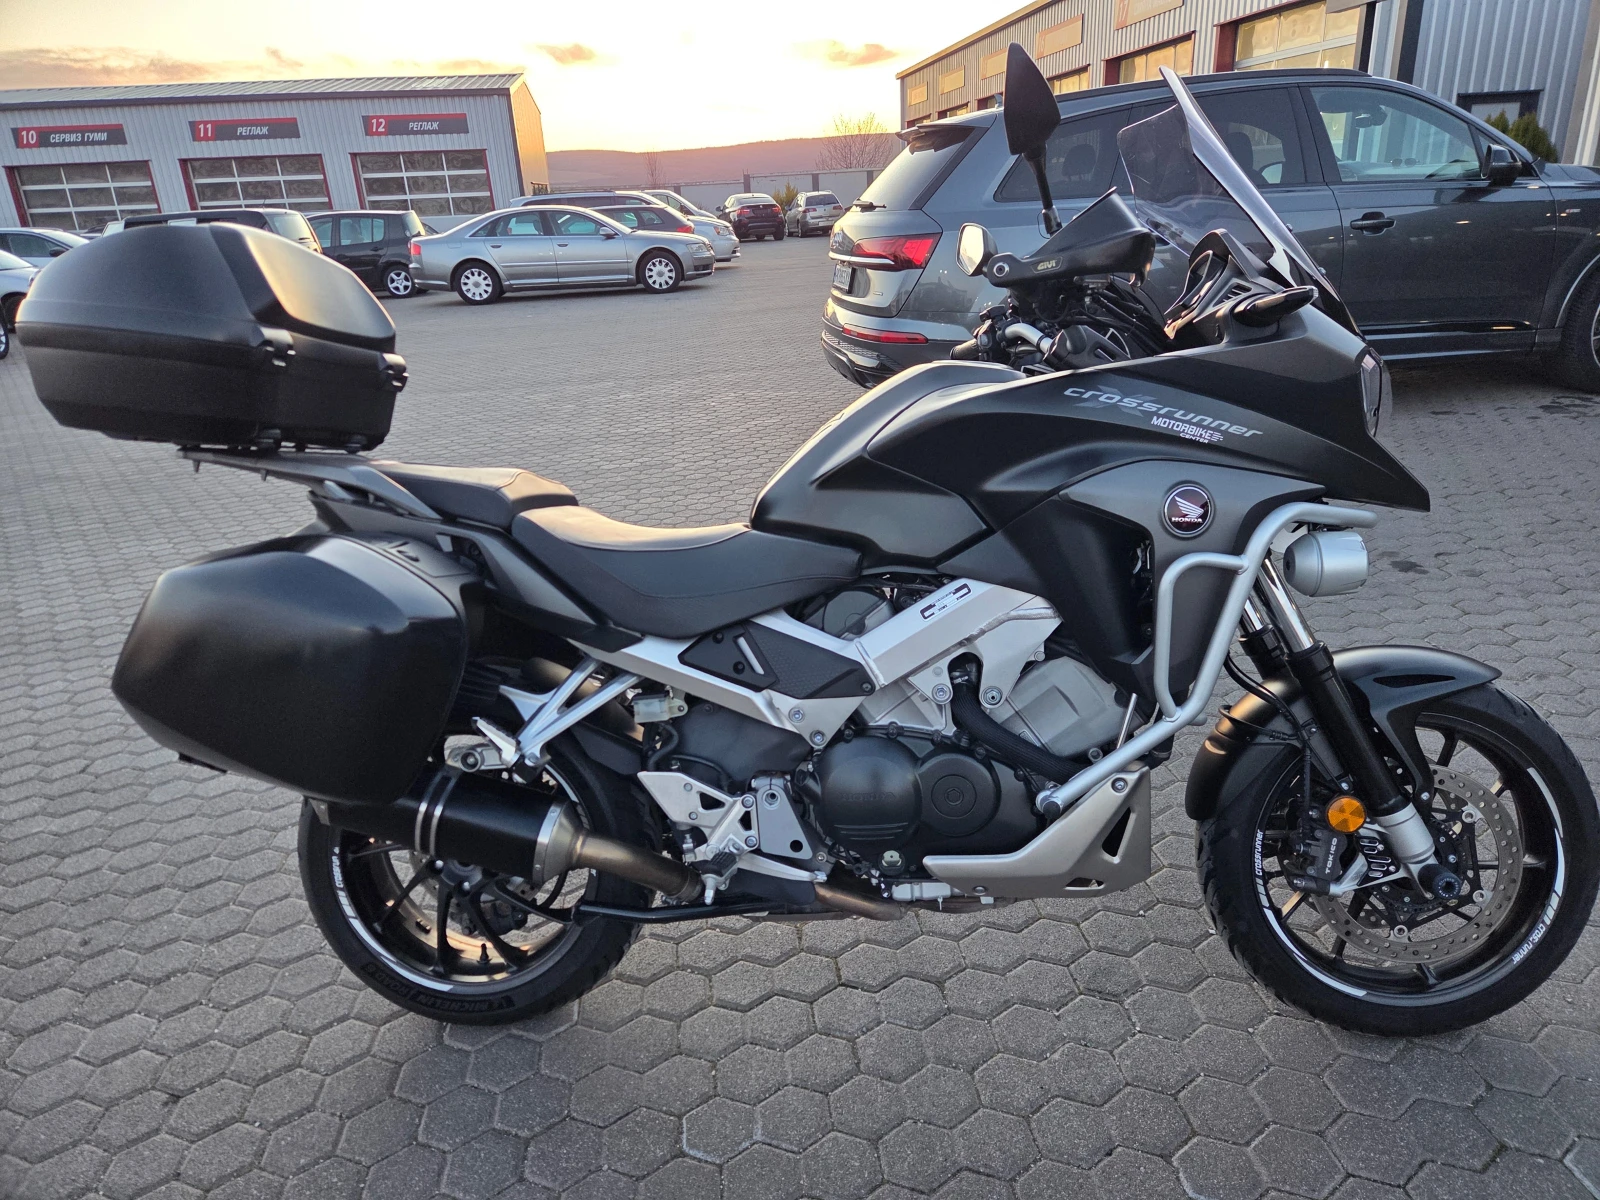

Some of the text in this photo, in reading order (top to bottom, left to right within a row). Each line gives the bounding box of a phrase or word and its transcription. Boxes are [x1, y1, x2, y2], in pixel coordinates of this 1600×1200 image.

[198, 123, 213, 138] 11
[236, 126, 269, 136] РЕГЛАЖ
[370, 118, 386, 132] 12
[408, 121, 440, 131] РЕГЛАЖ
[20, 130, 37, 144] 10
[50, 132, 108, 143] СЕРВИЗ ГУМИ
[1037, 260, 1057, 270] GIVI
[1063, 387, 1264, 438] crossrunner
[1151, 415, 1214, 440] MOTORBIKE
[1180, 432, 1209, 444] CENTER
[1325, 837, 1338, 875] TOKICO
[416, 993, 488, 1011] MICHELIN
